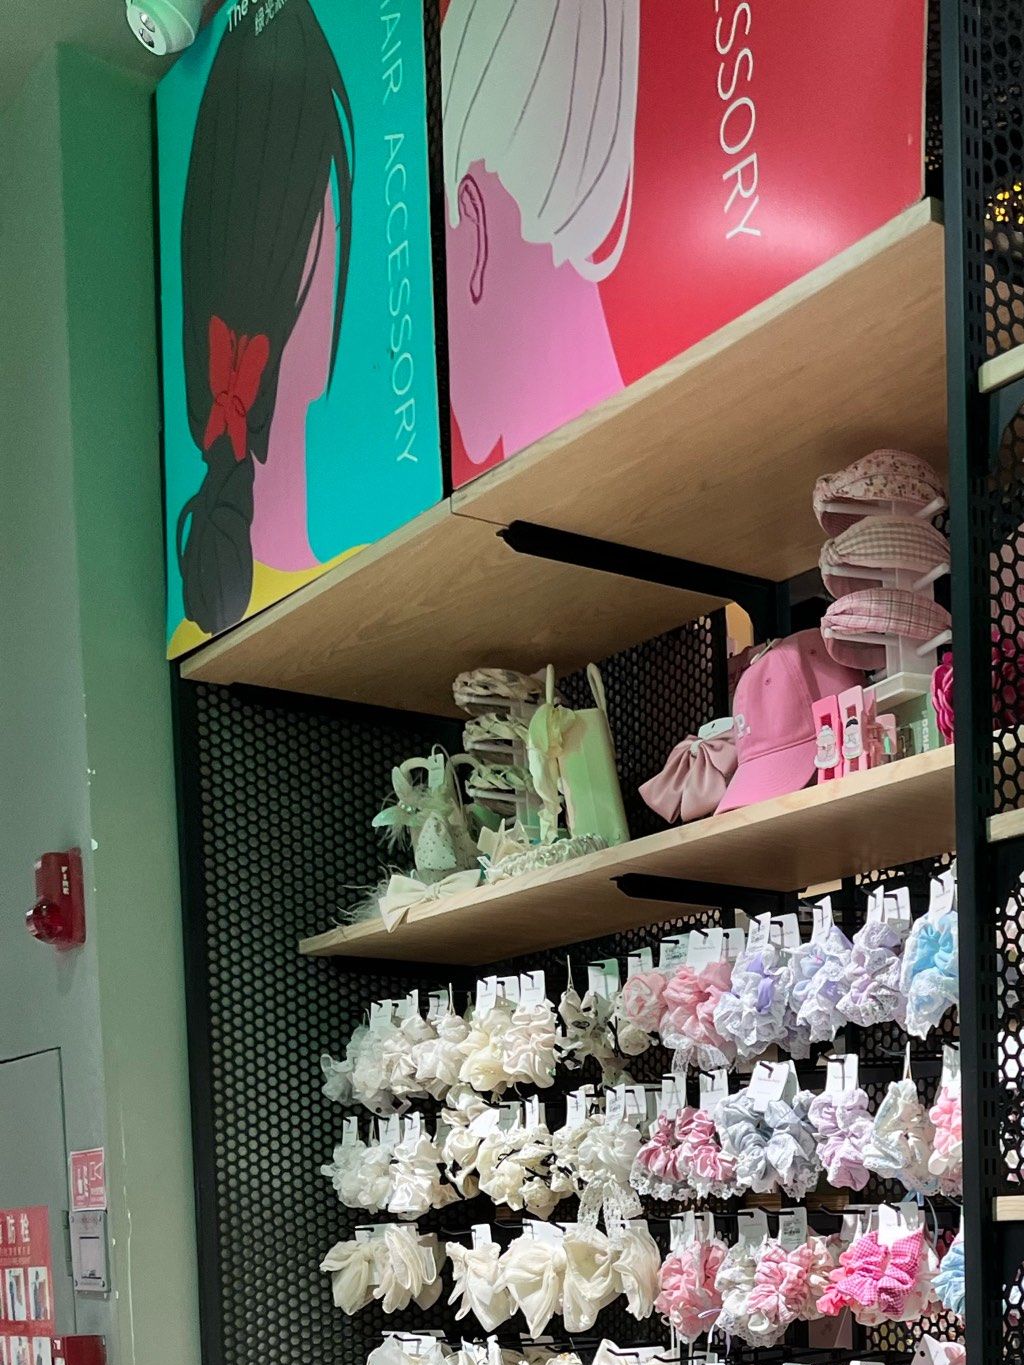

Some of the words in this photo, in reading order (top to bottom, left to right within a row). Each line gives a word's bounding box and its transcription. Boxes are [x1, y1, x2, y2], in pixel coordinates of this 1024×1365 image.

[380, 0, 403, 106] AIR
[714, 0, 761, 240] SSORY
[384, 133, 418, 462] ACCESSORY
